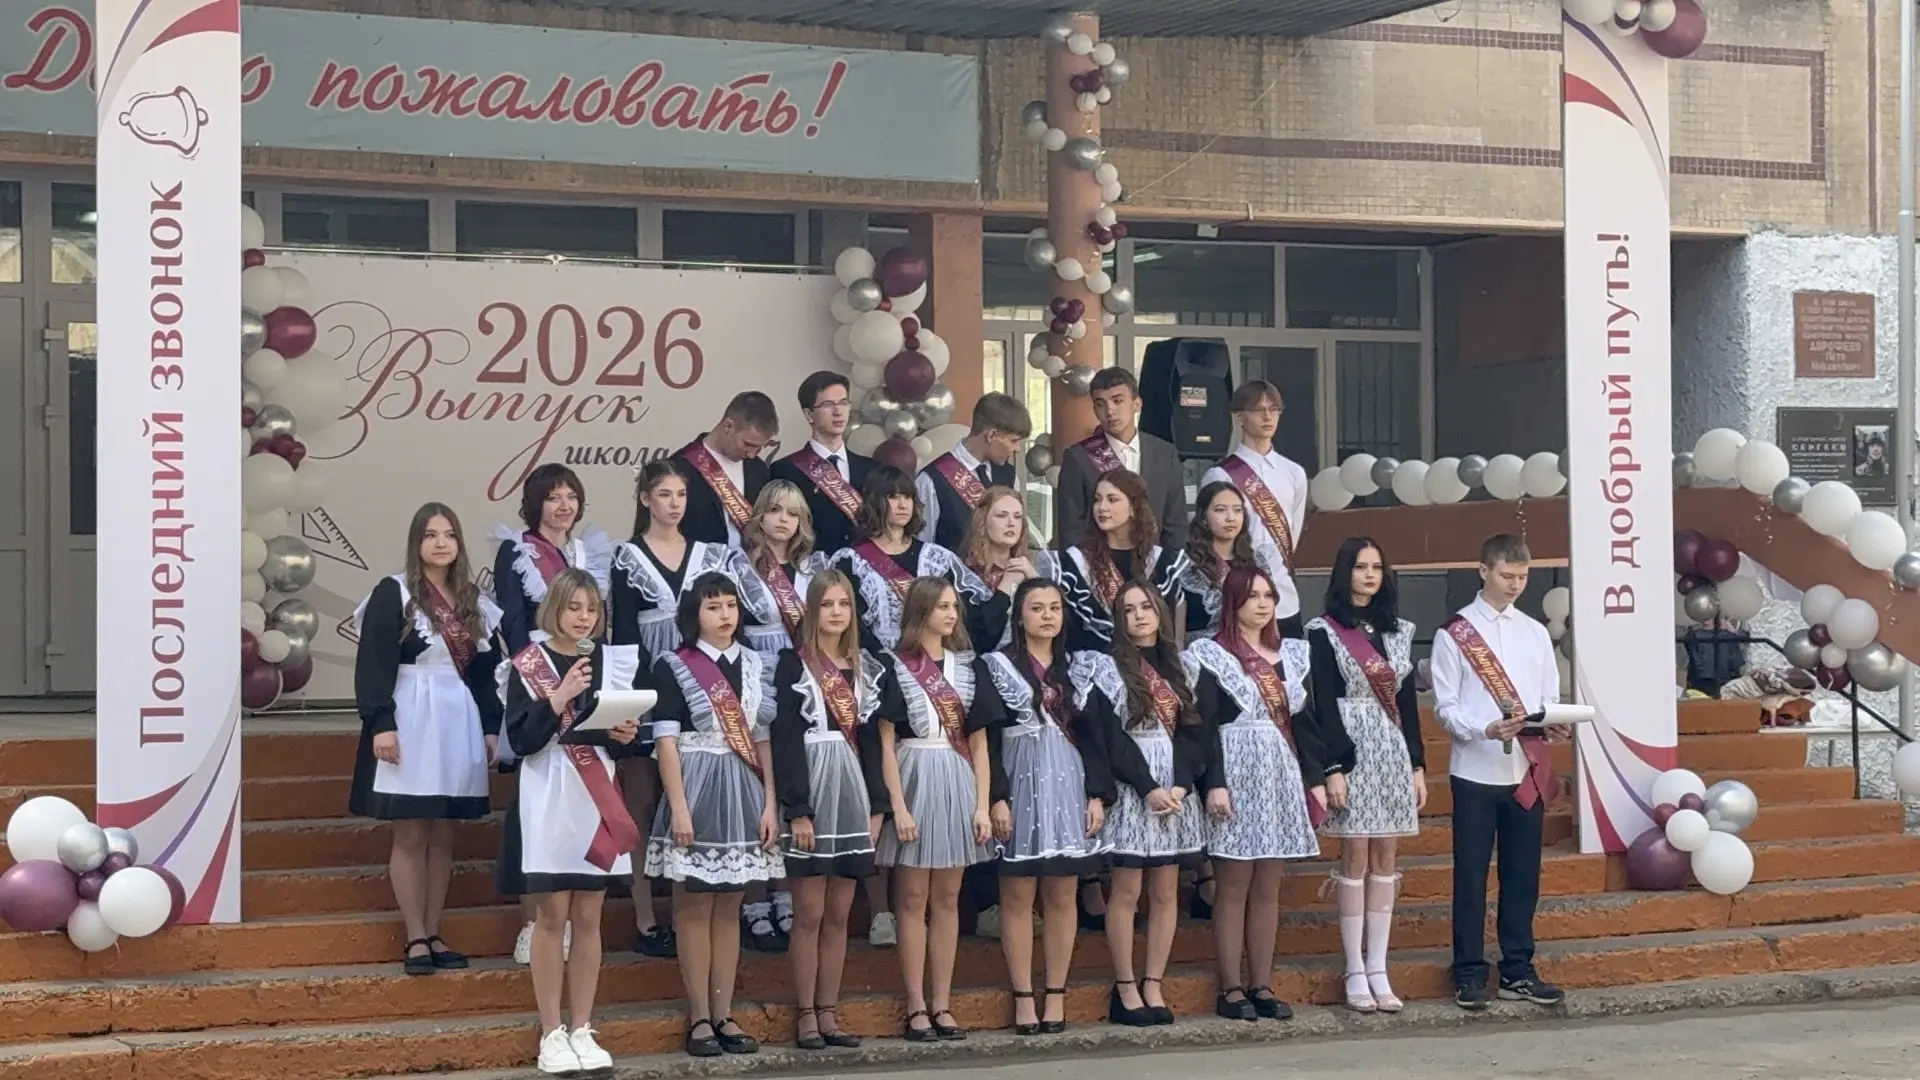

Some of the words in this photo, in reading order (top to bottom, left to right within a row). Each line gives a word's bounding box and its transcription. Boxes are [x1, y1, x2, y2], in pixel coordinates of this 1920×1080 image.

[309, 60, 846, 138] пожаловать!
[150, 180, 184, 391] звонок
[476, 301, 704, 390] 2026
[1596, 233, 1640, 358] путь!
[308, 301, 652, 502] Выпуск
[564, 441, 670, 467] школа
[1599, 374, 1642, 569] добрый
[140, 412, 195, 749] Последний
[1603, 582, 1636, 619] В
